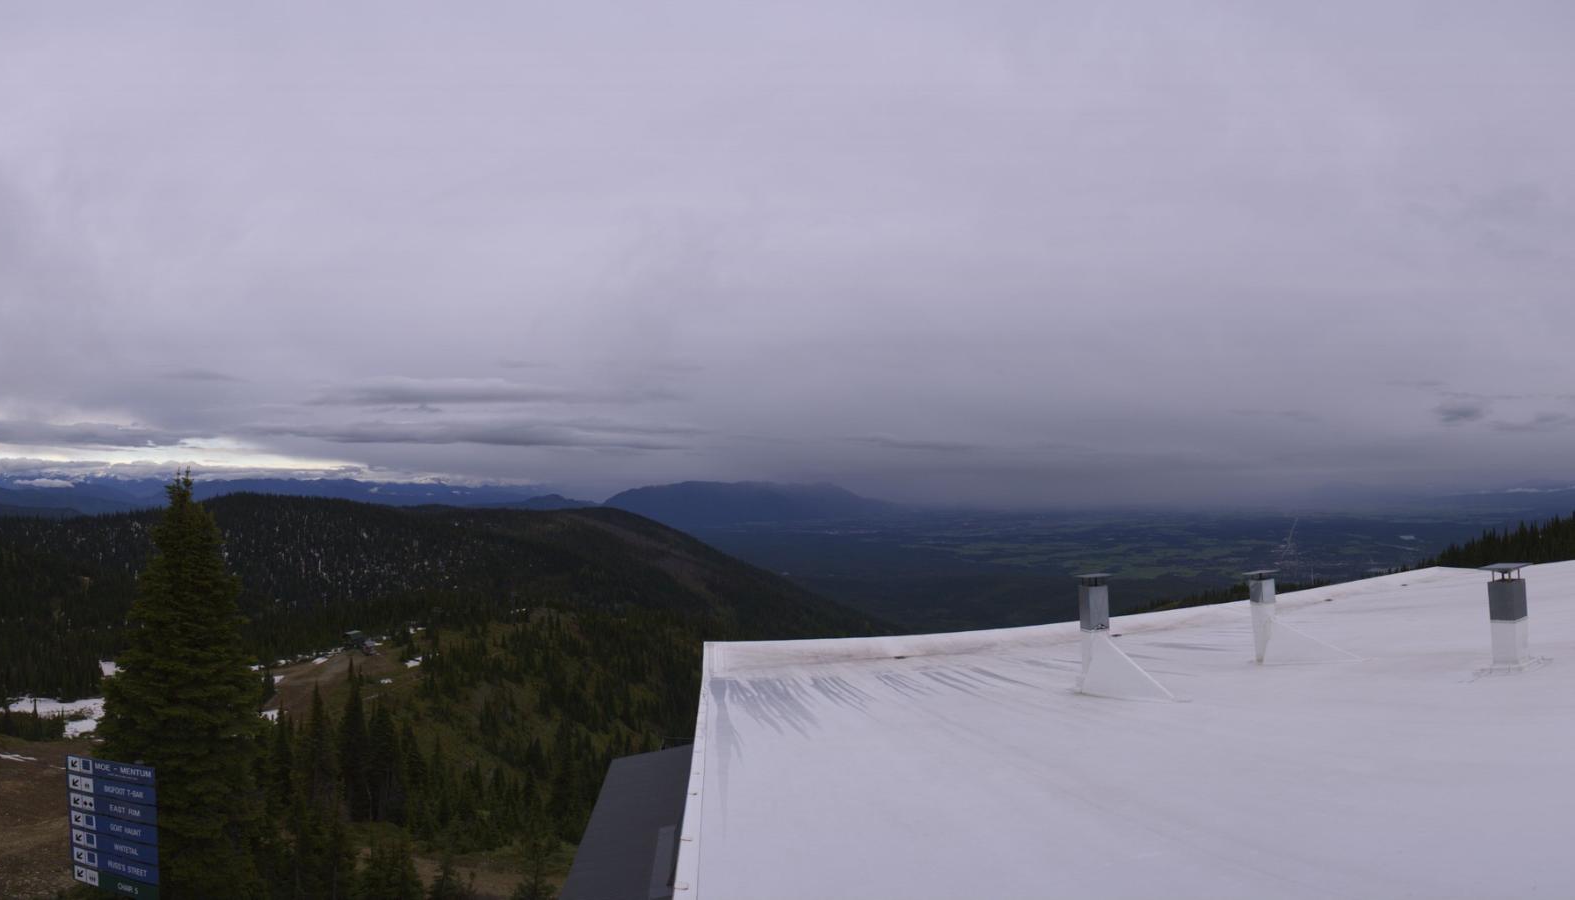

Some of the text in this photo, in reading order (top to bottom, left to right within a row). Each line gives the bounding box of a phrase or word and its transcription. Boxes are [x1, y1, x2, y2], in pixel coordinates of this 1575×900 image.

[94, 762, 111, 772] MOE
[120, 766, 152, 777] MENTUM
[109, 804, 141, 816] EAST RIM
[127, 865, 147, 877] STREET
